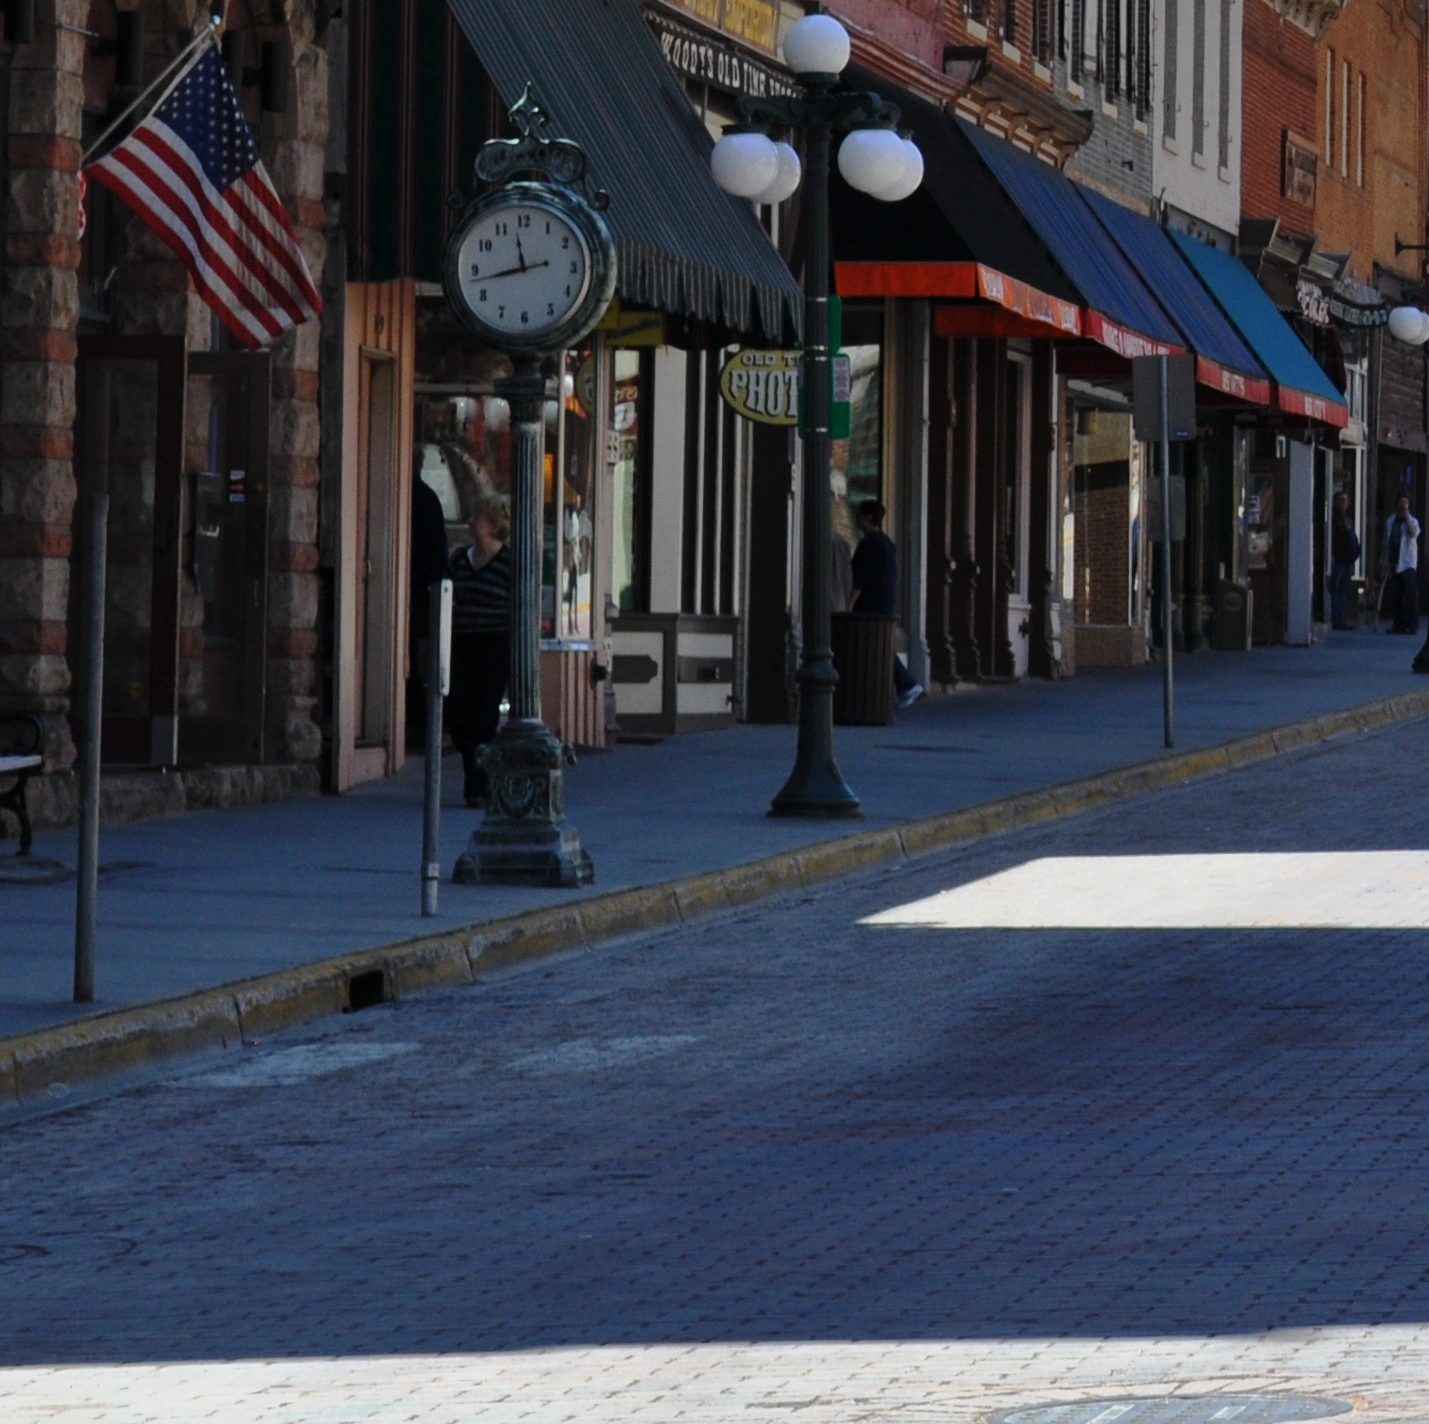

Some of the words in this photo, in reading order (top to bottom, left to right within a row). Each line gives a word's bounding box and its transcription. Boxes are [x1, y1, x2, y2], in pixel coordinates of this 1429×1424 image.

[718, 52, 741, 88] OLD
[518, 215, 530, 228] 12
[496, 223, 507, 236] 11
[546, 222, 550, 235] 1
[479, 240, 492, 252] 10
[561, 237, 569, 249] 2
[471, 264, 479, 276] 9
[570, 262, 577, 274] 3
[479, 289, 487, 301] 8
[565, 285, 570, 297] 4
[498, 306, 505, 319] 7
[546, 303, 554, 316] 5
[521, 311, 528, 324] 6
[742, 353, 776, 366] OLD
